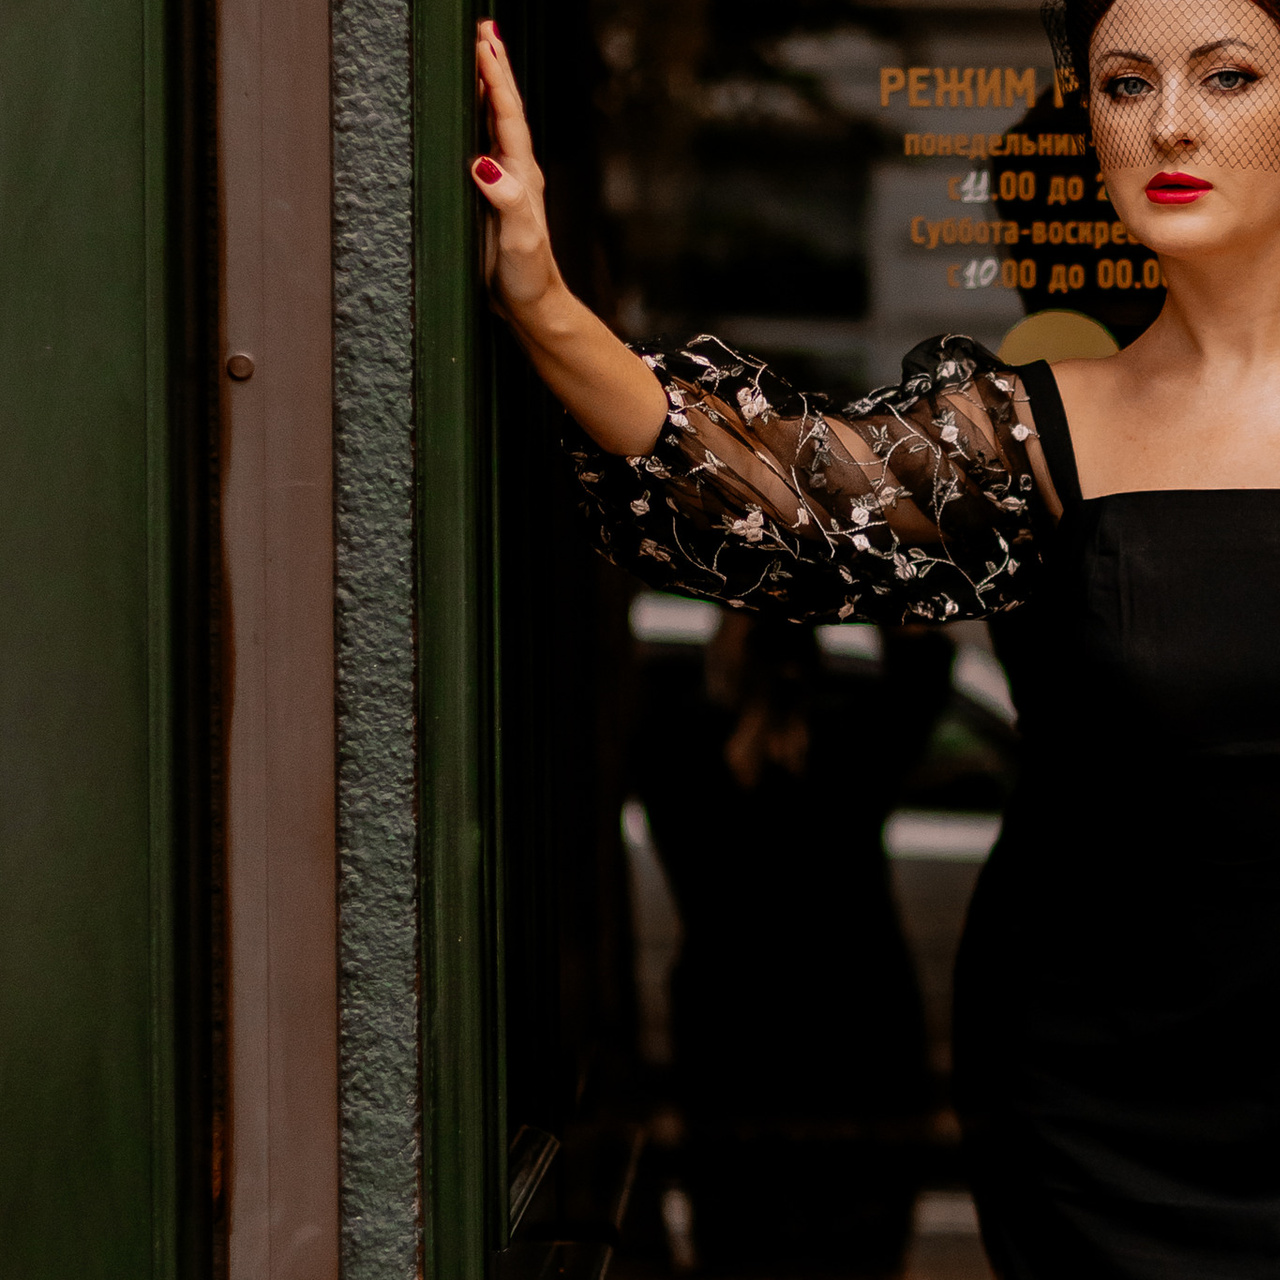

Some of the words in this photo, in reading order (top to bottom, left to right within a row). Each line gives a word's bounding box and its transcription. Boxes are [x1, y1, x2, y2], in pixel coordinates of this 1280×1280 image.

[880, 67, 1036, 109] РЕЖИМ
[1048, 176, 1084, 206] до
[1048, 263, 1085, 294] до
[1096, 258, 1166, 290] 00.0
